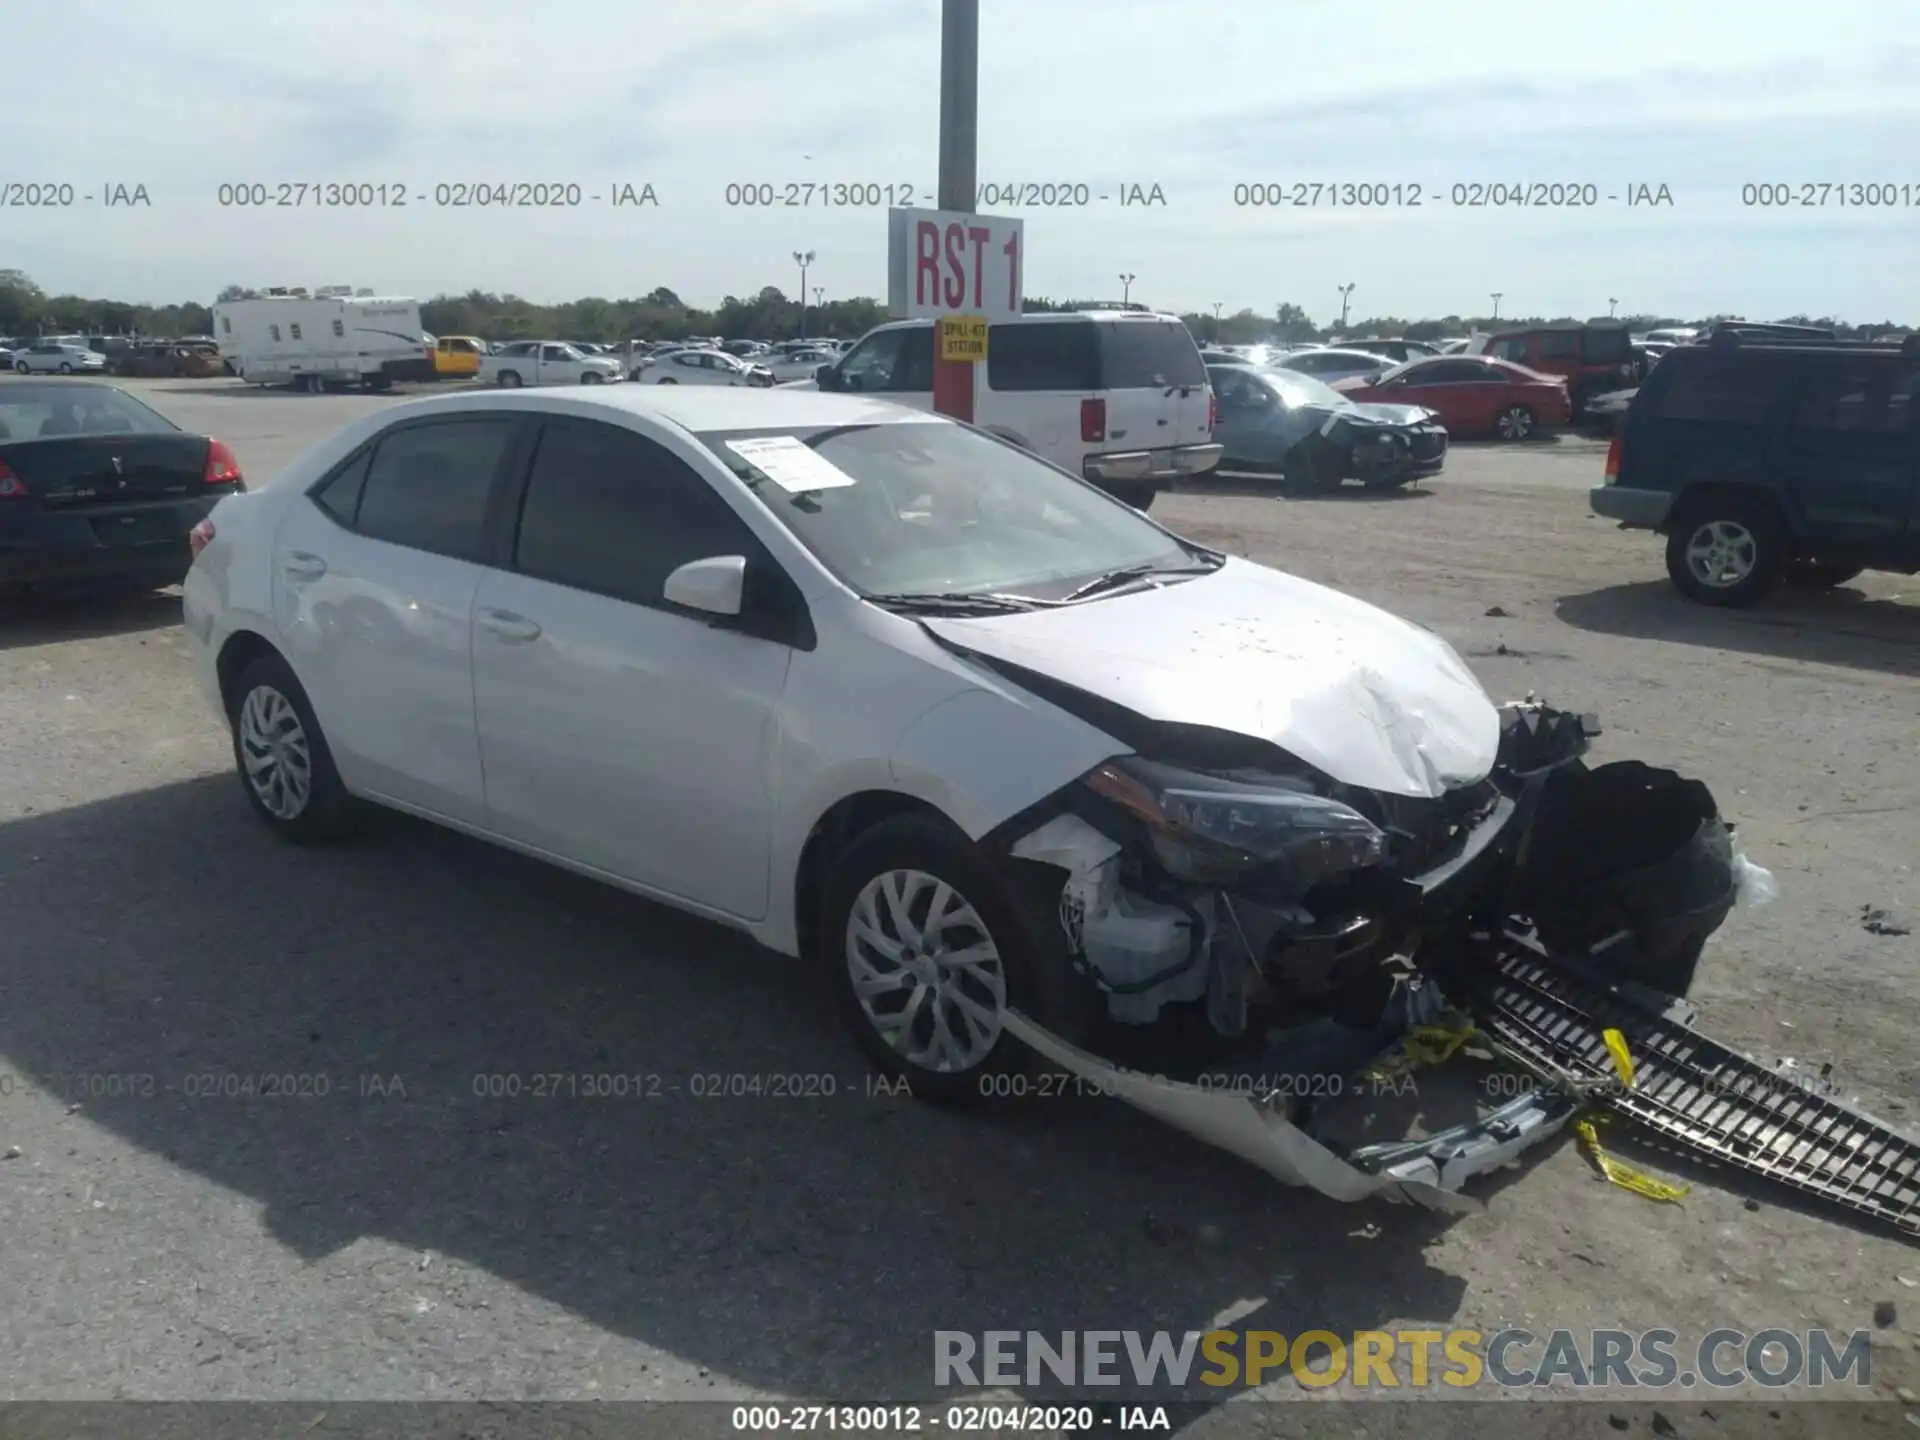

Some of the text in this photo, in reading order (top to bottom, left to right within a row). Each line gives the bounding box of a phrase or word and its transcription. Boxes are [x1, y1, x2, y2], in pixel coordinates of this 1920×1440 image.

[917, 221, 1018, 312] RST 1
[947, 340, 983, 353] STATION
